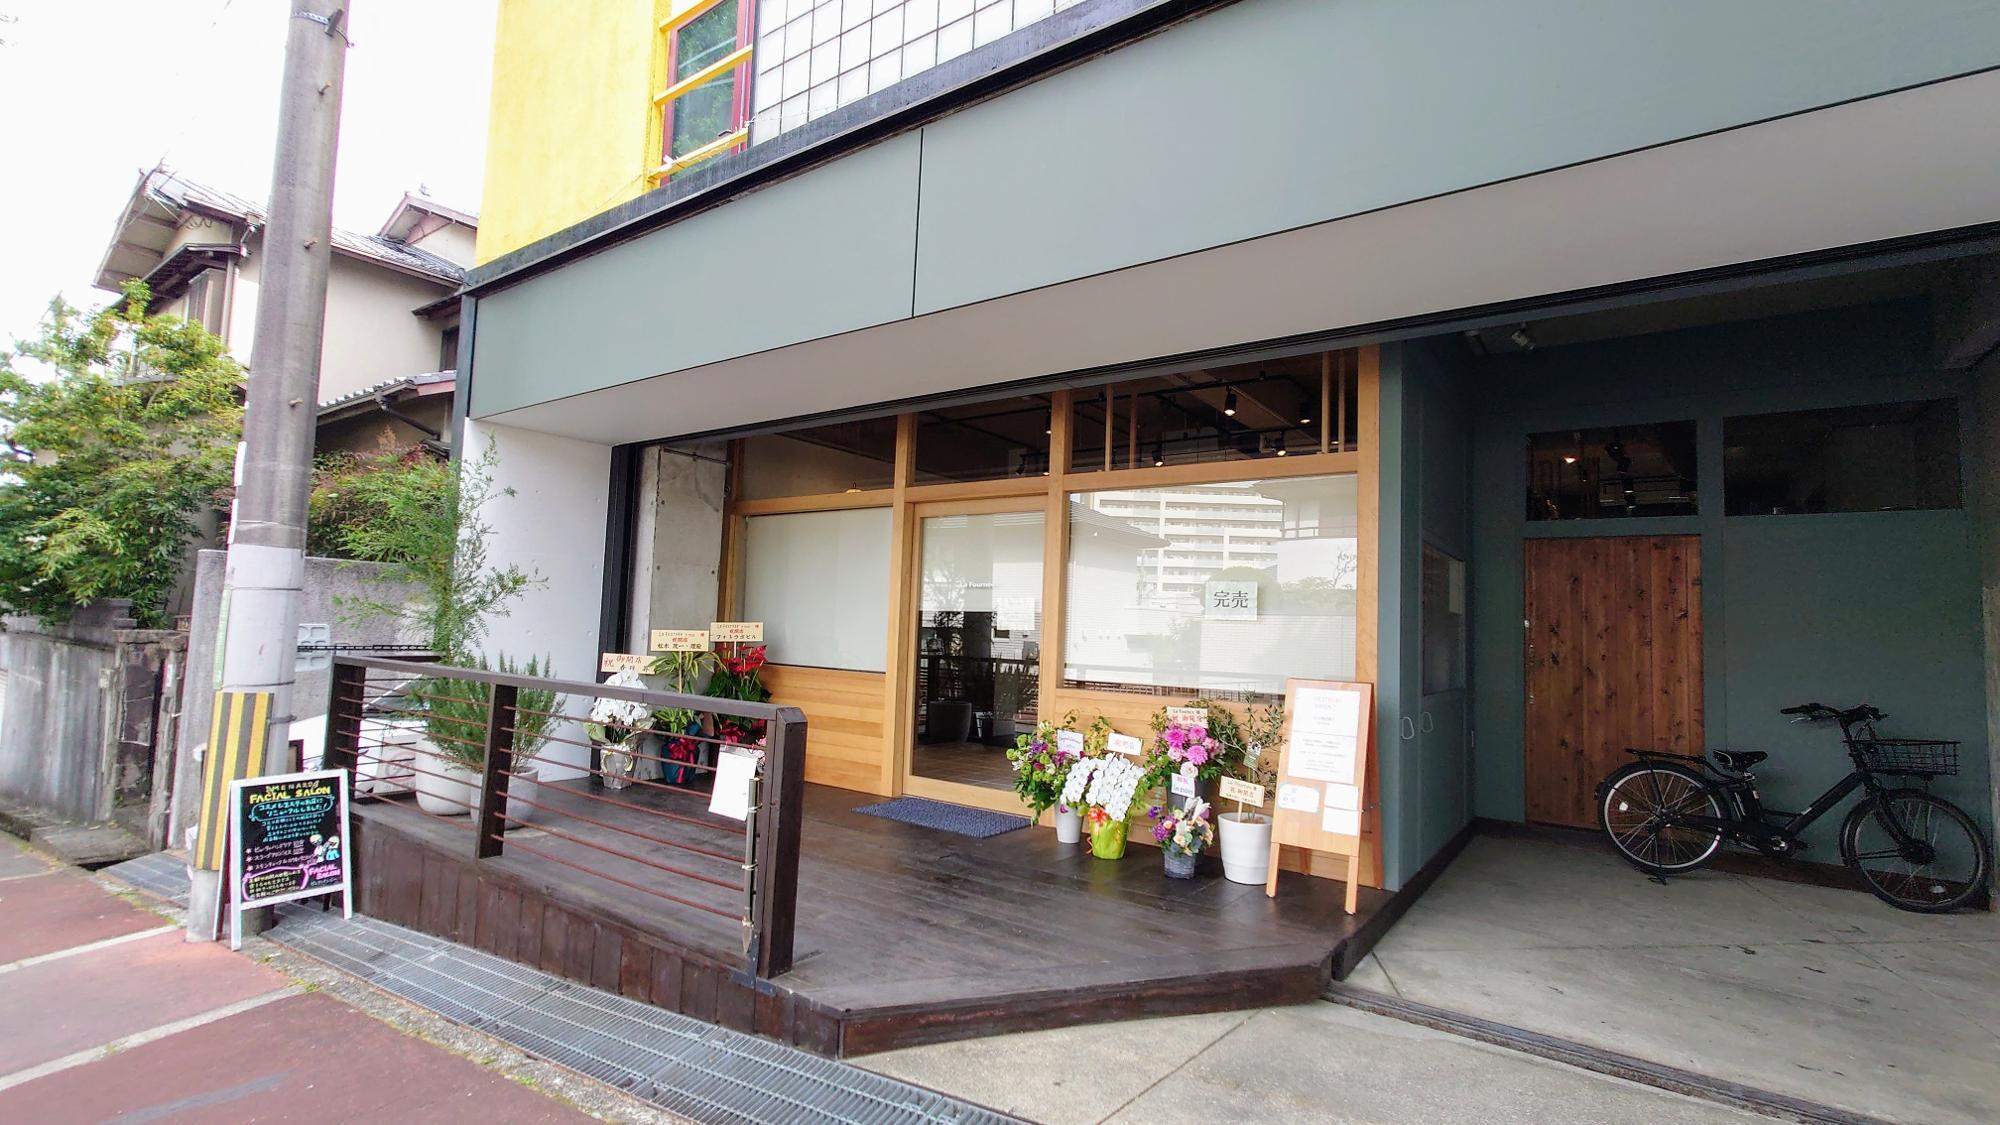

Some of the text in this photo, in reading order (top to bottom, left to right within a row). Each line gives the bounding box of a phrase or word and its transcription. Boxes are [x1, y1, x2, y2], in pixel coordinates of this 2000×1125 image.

[1213, 590, 1248, 608] 完売
[249, 786, 331, 804] FACIAL SALON
[308, 863, 338, 875] FACIAL
